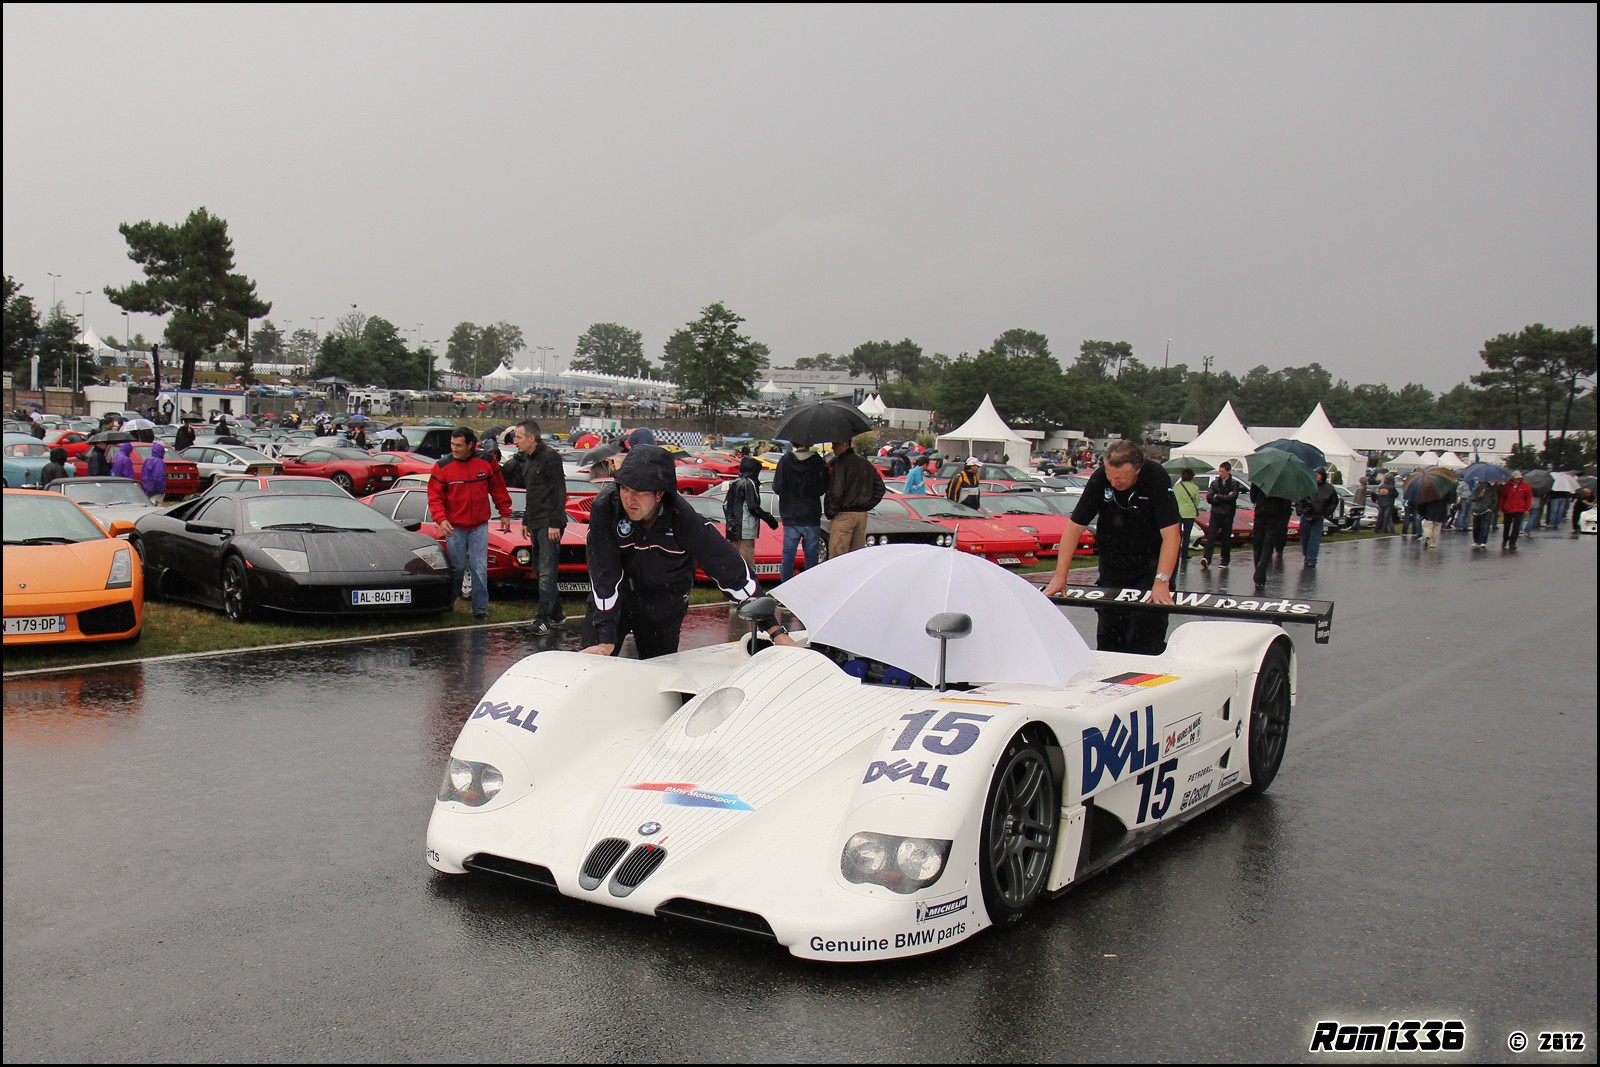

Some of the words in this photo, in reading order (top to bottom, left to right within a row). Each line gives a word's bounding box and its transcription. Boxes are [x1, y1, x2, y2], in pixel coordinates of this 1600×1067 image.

[1386, 436, 1496, 450] www.lemans.org
[1214, 597, 1311, 614] parts
[472, 701, 539, 733] DELL
[891, 709, 994, 756] 15
[1081, 705, 1160, 796] DELL
[862, 758, 950, 791] DELL
[664, 786, 689, 795] BMW
[688, 790, 737, 805] Motorsport
[1136, 757, 1179, 824] 15
[928, 897, 967, 917] MICHELIN
[810, 936, 889, 952] Genuine
[895, 928, 935, 949] BMW
[937, 921, 966, 944] parts
